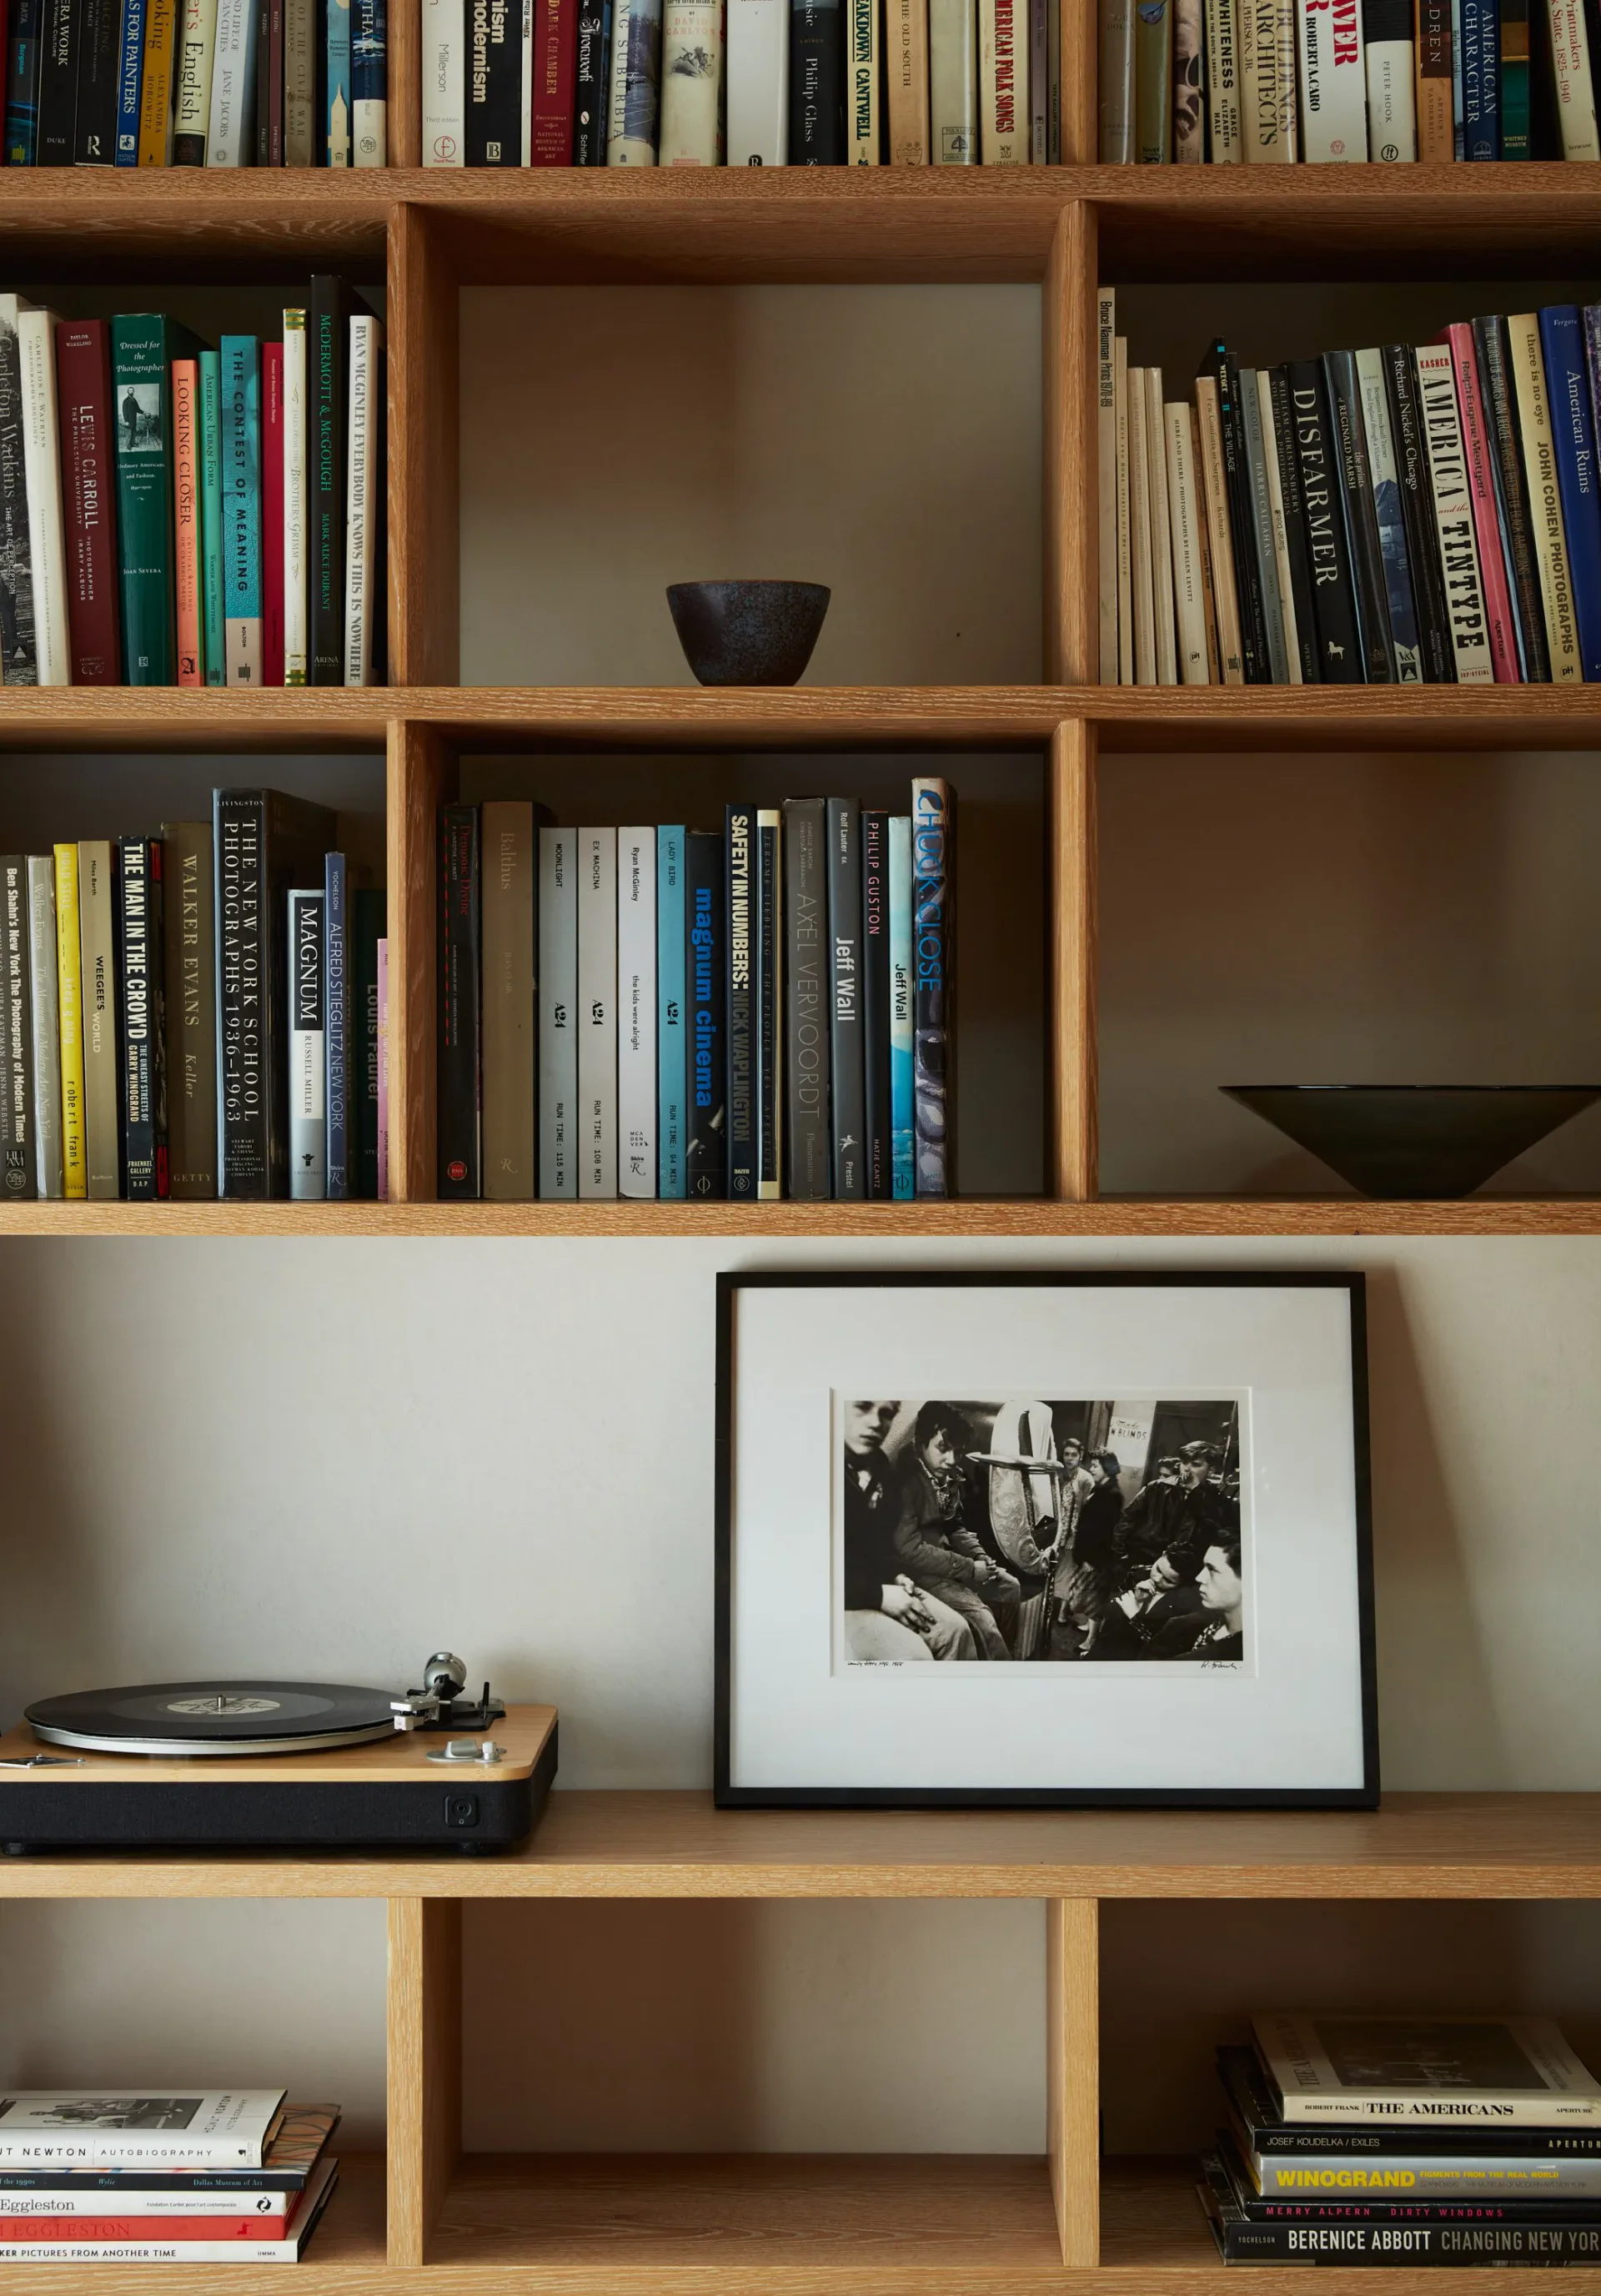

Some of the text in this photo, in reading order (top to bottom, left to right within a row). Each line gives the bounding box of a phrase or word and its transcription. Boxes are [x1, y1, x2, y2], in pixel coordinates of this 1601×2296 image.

[18, 44, 27, 74] Bergman
[58, 25, 70, 66] WORK
[123, 13, 140, 114] FOR PAINTERS
[219, 20, 229, 53] CITIES
[439, 44, 450, 93] Millerson
[546, 37, 560, 94] CHAMBER
[901, 23, 911, 87] OLD SOUTH
[1277, 8, 1297, 133] BUILDINGS
[1306, 17, 1319, 66] ROBERT
[1466, 3, 1481, 123] CHARACTER
[1482, 9, 1498, 114] AMERICAN
[144, 75, 154, 130] HOROWITZ
[155, 73, 165, 133] ALEXANDRA
[180, 38, 203, 121] English
[219, 69, 233, 138] JANE JACOBS
[614, 40, 628, 138] SUBURBIA
[803, 58, 819, 143] Philip Glass
[856, 68, 871, 141] CANTWELL
[995, 59, 1015, 133] FOLK SONGS
[1383, 61, 1393, 123] PETER HOOK
[580, 134, 589, 165] Schiffer
[1222, 98, 1230, 148] ELIZABETH
[233, 351, 243, 382] THE
[1100, 301, 1113, 360] Bruce Nauman
[1420, 358, 1450, 368] KASHER
[234, 392, 246, 467] CONTEST
[320, 314, 332, 491] McDERMOTT McGOUGH
[1393, 359, 1419, 490] Richard Nickel's Chicago
[1567, 370, 1592, 494] American Ruins
[80, 405, 99, 529] LEWIS CARROLL
[177, 378, 191, 526] LOOKING CLOSER
[1225, 423, 1237, 472] THE VILLAGE
[1465, 394, 1488, 498] Eugene Meatyard
[350, 325, 367, 681] RYAN MCGINLEY EVERYBODY KNOWS THIS NOWHERE
[1180, 486, 1188, 538] PHOTOGRAPHS
[1216, 506, 1227, 539] Richards
[1255, 462, 1272, 556] HARRY CALLAHAN
[1292, 387, 1339, 586] DISFARMER
[1422, 378, 1485, 649] AMERICA TINTYPE
[1526, 334, 1574, 654] there is no eye JOHN COHEN PHOTOGRAPHS
[236, 509, 248, 592] MEANING
[322, 513, 331, 611] MARK ALICE DURANT
[124, 843, 146, 938] THE MAN IN
[500, 832, 516, 889] Balthus
[631, 867, 640, 902] McGinley
[868, 822, 881, 934] PHILIP GUSTON
[918, 791, 942, 991] CHUCK CLOSE
[224, 821, 239, 993] PHOTOGRAPHS
[731, 815, 749, 989] SAFETY NUMBERS:
[183, 854, 199, 1098] WALKER EVANS Keller
[243, 880, 258, 1122] NEW YORK SCHOOL
[300, 907, 319, 1022] MAGNUM
[329, 922, 344, 1051] ALFRED STIEGLITZ
[690, 888, 718, 1107] magnum cinema
[836, 937, 856, 1021] Jeff Wall
[8, 867, 26, 1143] Ben Shahn's Times
[93, 956, 105, 1053] WEEGEE'S WORLD
[555, 1002, 566, 1028] A24
[593, 999, 604, 1025] A24
[630, 1026, 640, 1050] alright
[797, 893, 820, 1118] AXEL VERVOORDT
[896, 992, 907, 1020] Wall
[128, 1044, 140, 1123] GARRY WINOGRAND
[304, 1035, 313, 1114] RUSSELL MILLER
[733, 1032, 750, 1142] WAPLINGTON
[846, 1161, 854, 1188] Prestel
[1267, 2138, 1380, 2148] JOSEF KOUDELKA EXILES
[1366, 2103, 1514, 2116] THE AMERICANS
[23, 2148, 213, 2157] NEWTON AUTOBIOGRAPHY
[1276, 2170, 1416, 2188] WINOGRAND
[0, 2198, 75, 2213] Eggleston
[1266, 2207, 1503, 2218] MERRY ALPERN DIRTY WINDOWS
[1287, 2229, 1563, 2251] BERENICE ABBOTT CHANGING NEW
[21, 2249, 177, 2258] PICTURES FROM ANOTHER TIME
